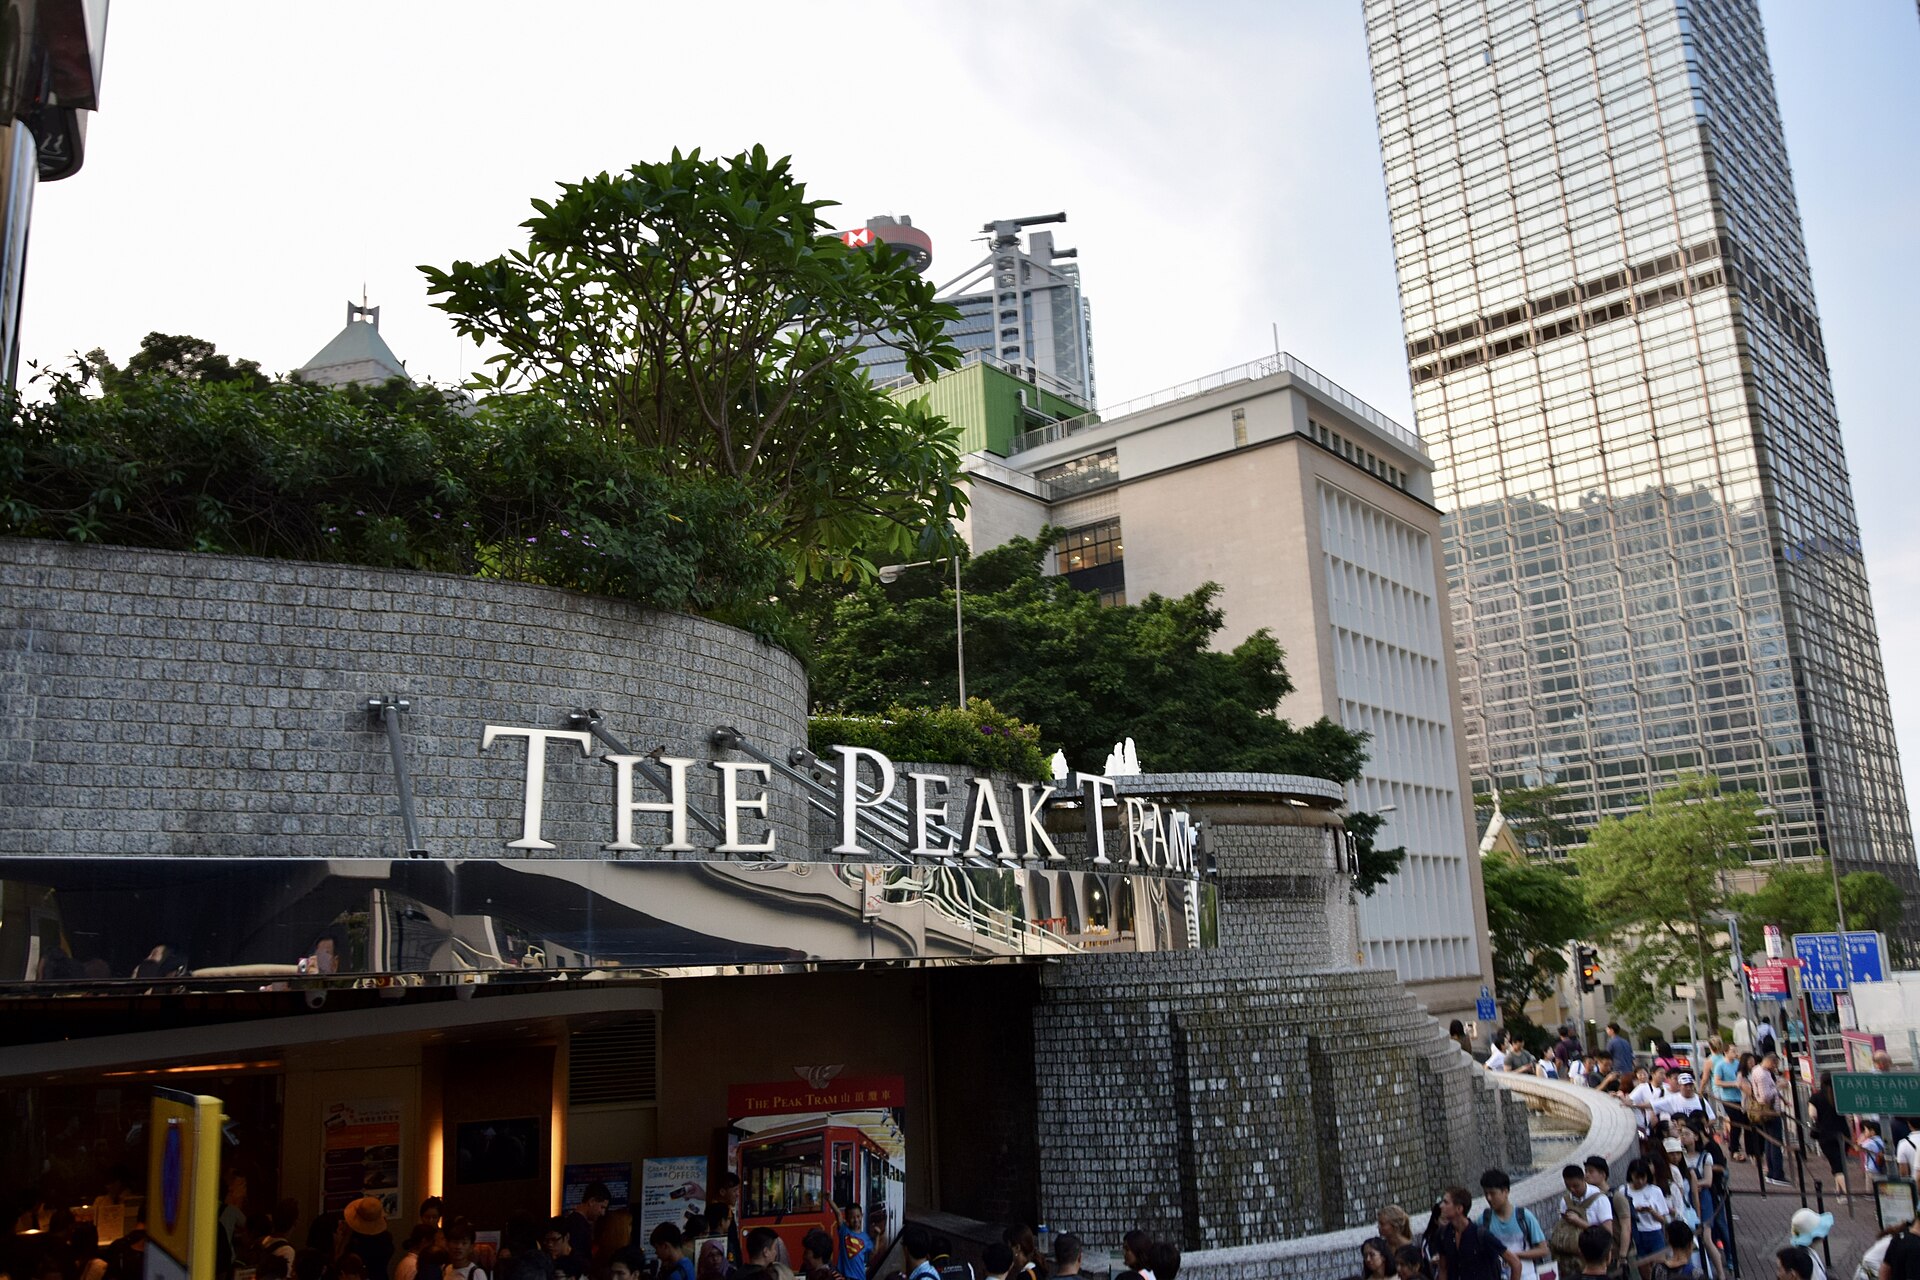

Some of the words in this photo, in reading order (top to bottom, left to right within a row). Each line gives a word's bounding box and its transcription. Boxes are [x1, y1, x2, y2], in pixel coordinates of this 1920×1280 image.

[482, 724, 775, 852] THE
[831, 744, 1067, 861] PEAK
[1075, 771, 1195, 873] TRAM
[1837, 1077, 1868, 1089] TAXI
[1871, 1076, 1919, 1090] STAND
[745, 1097, 769, 1110] THE
[773, 1095, 803, 1109] PEAK
[805, 1093, 838, 1106] TRAM
[1855, 1094, 1908, 1109] 的士站
[668, 1171, 701, 1180] OFFERS
